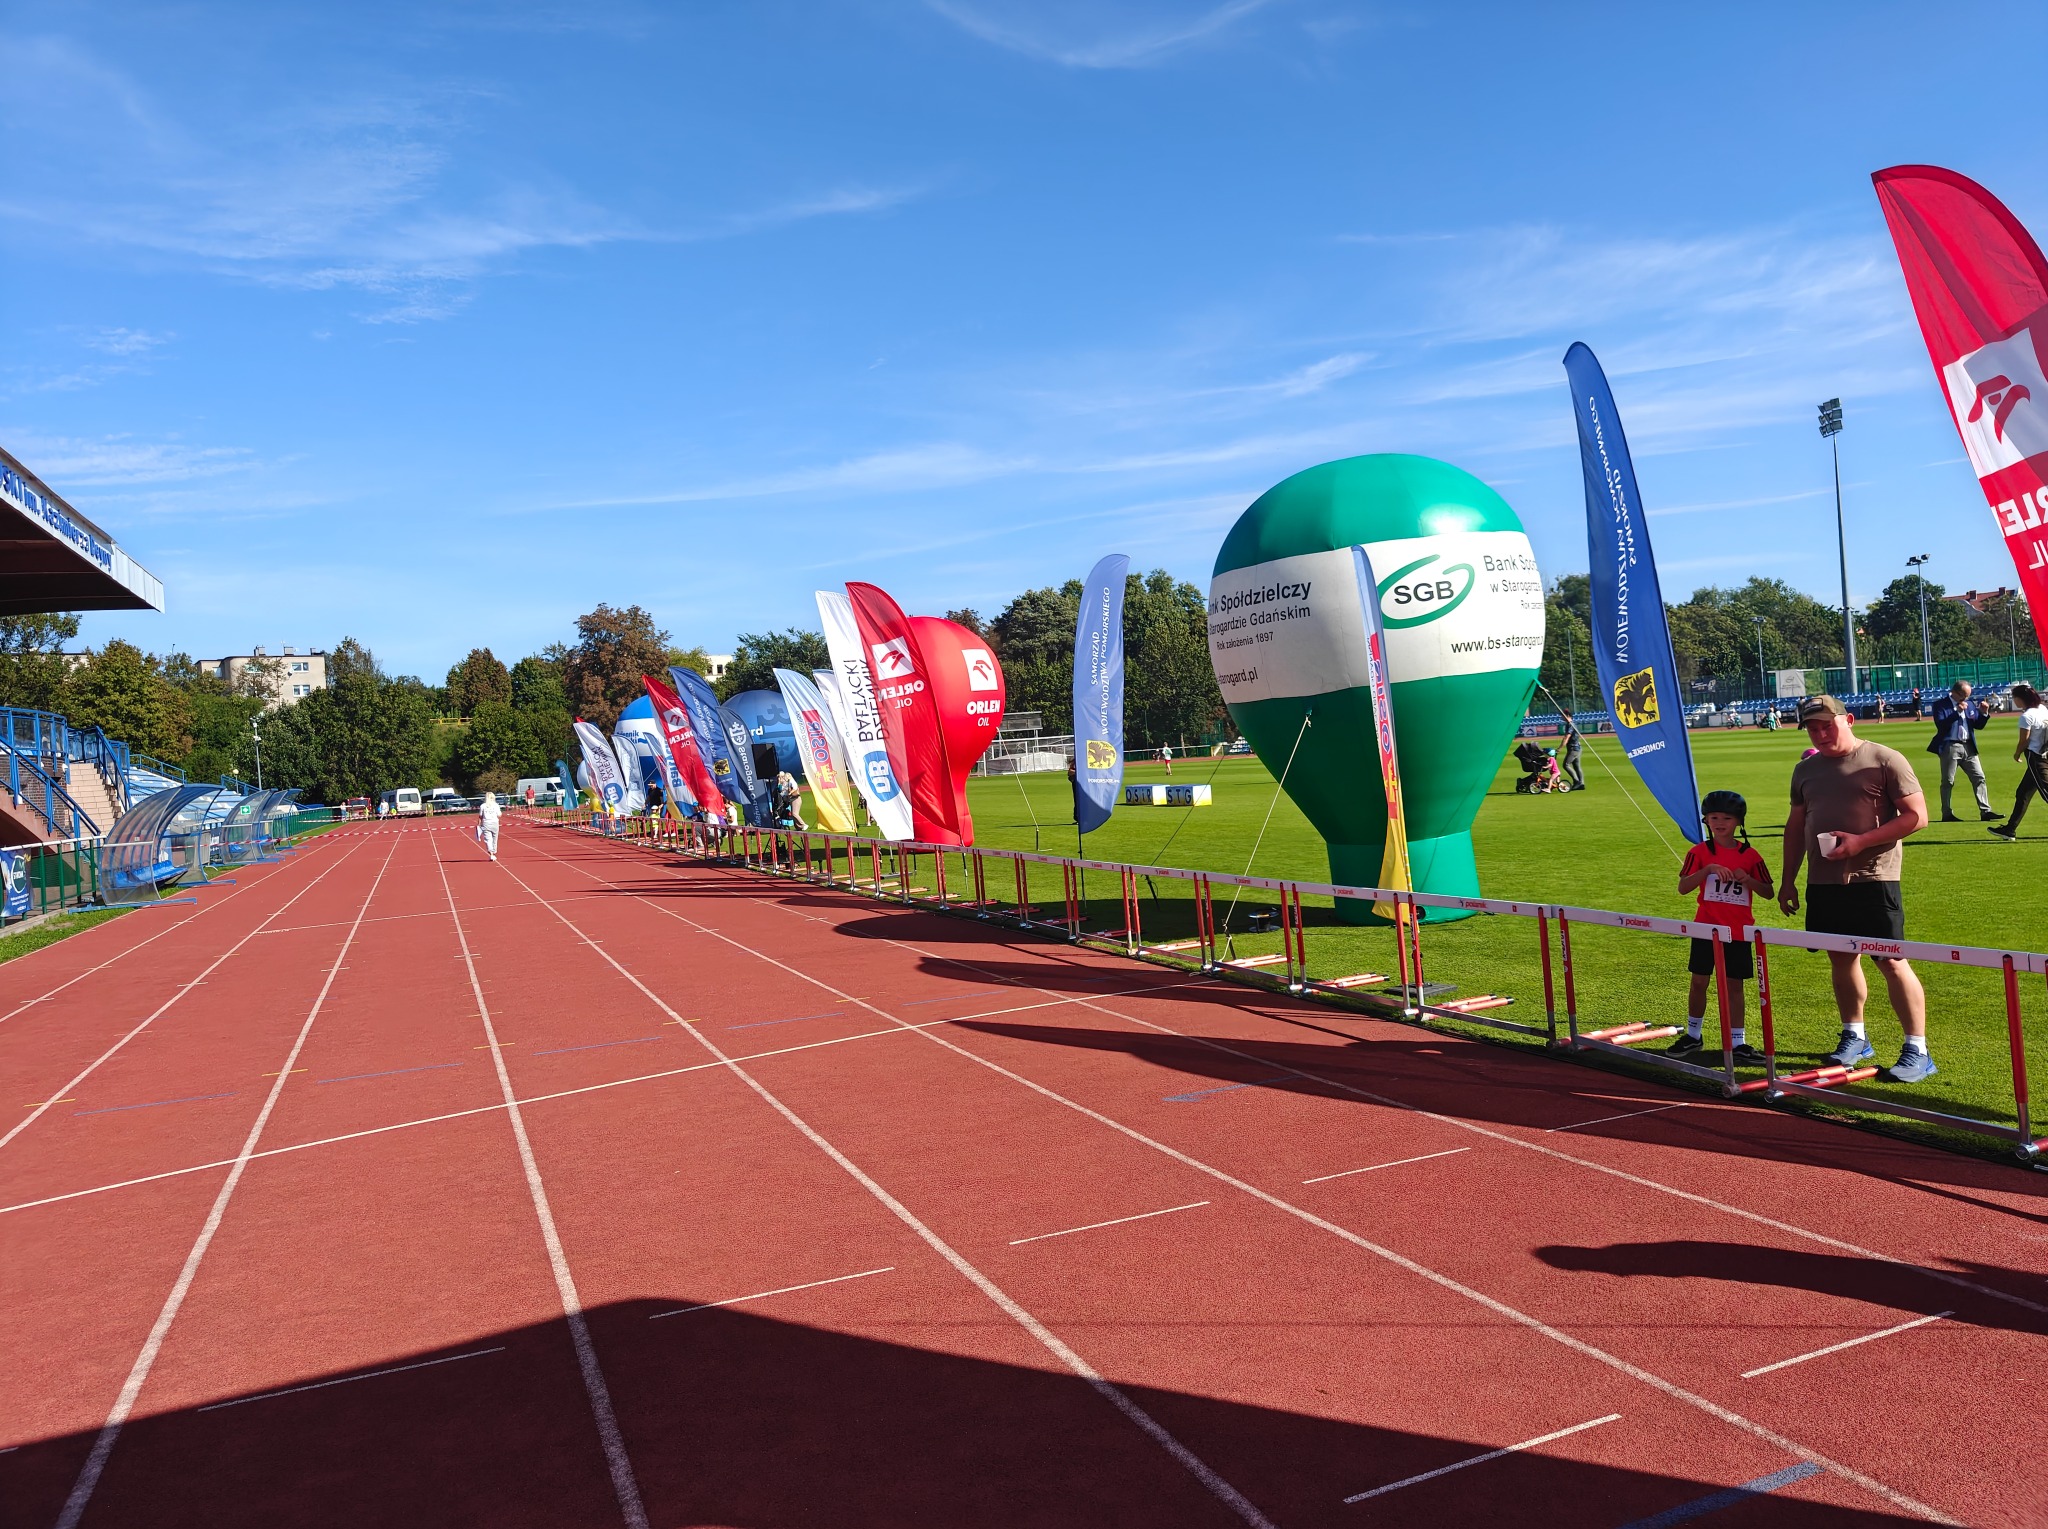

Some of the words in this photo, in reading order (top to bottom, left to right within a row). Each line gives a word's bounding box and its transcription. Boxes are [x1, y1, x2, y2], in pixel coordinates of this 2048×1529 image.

[1483, 554, 1519, 572] Bank
[1393, 580, 1455, 605] SGB
[1489, 583, 1499, 593] w
[1220, 582, 1312, 614] Spółdzielczy
[1100, 587, 1110, 658] POMORSKIEGO
[1249, 605, 1311, 626] Gdańskim
[1226, 636, 1254, 649] założenia
[1255, 631, 1274, 643] 1897
[1091, 631, 1100, 686] SAMORZĄD
[1100, 659, 1110, 735] WOJEWÓDZTWA
[966, 700, 1001, 715] ORLEN
[977, 717, 990, 727] OIL
[1125, 788, 1152, 803] OSiR
[1166, 788, 1192, 804] STG
[1714, 879, 1743, 895] 175
[1625, 918, 1652, 928] polanik
[1860, 942, 1902, 954] polanik
